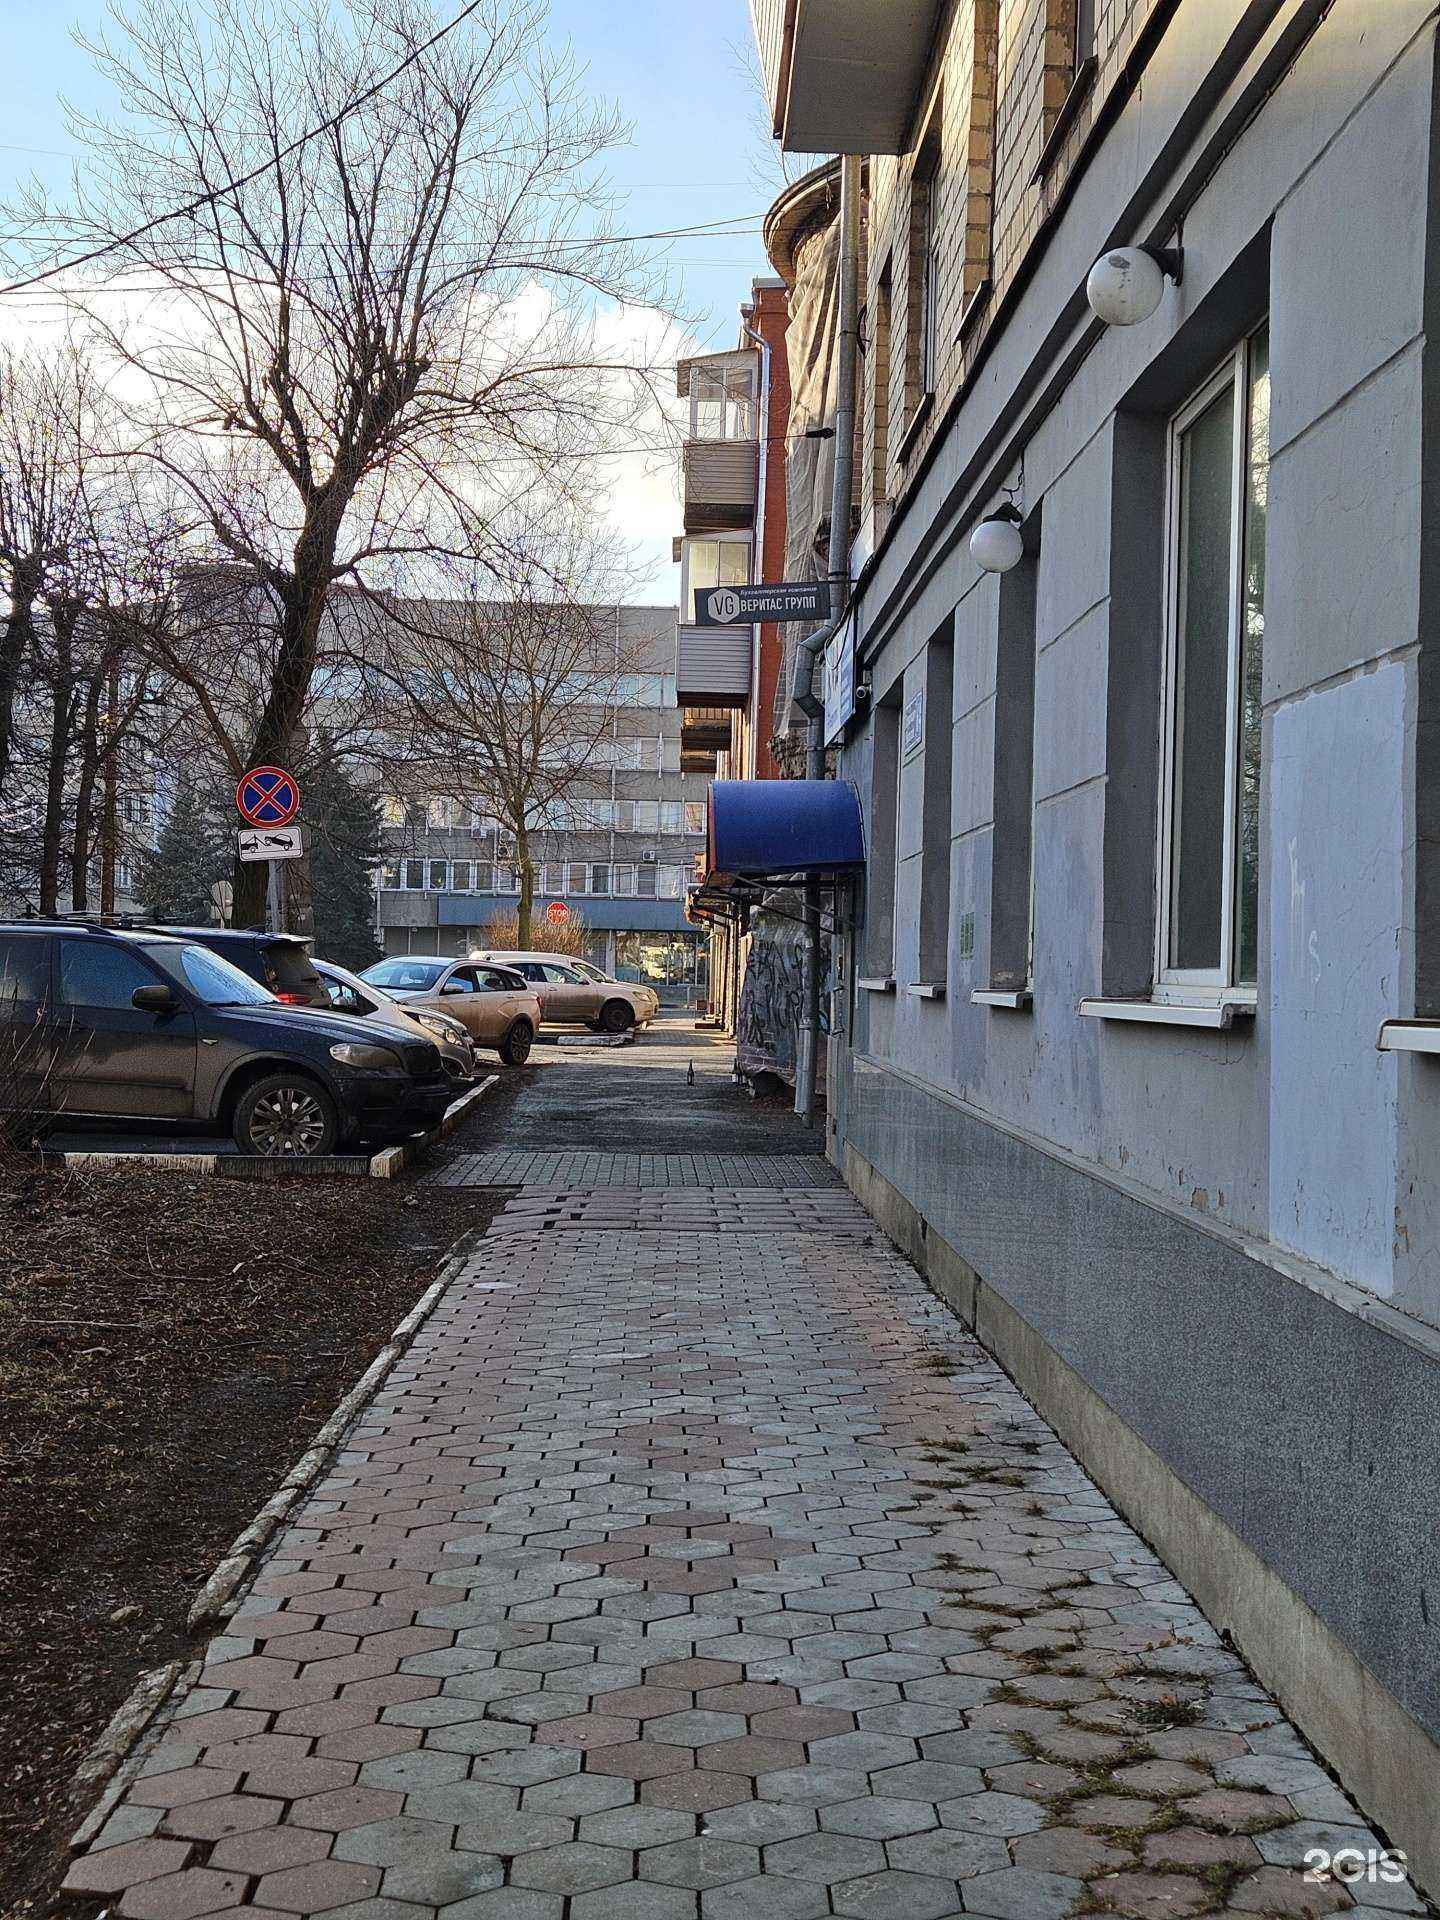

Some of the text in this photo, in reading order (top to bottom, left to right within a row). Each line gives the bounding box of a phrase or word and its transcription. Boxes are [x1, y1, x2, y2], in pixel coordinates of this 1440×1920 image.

[714, 595, 734, 615] VG
[741, 596, 815, 612] ВЕРИТАС ГРУПП
[548, 909, 567, 918] STOP
